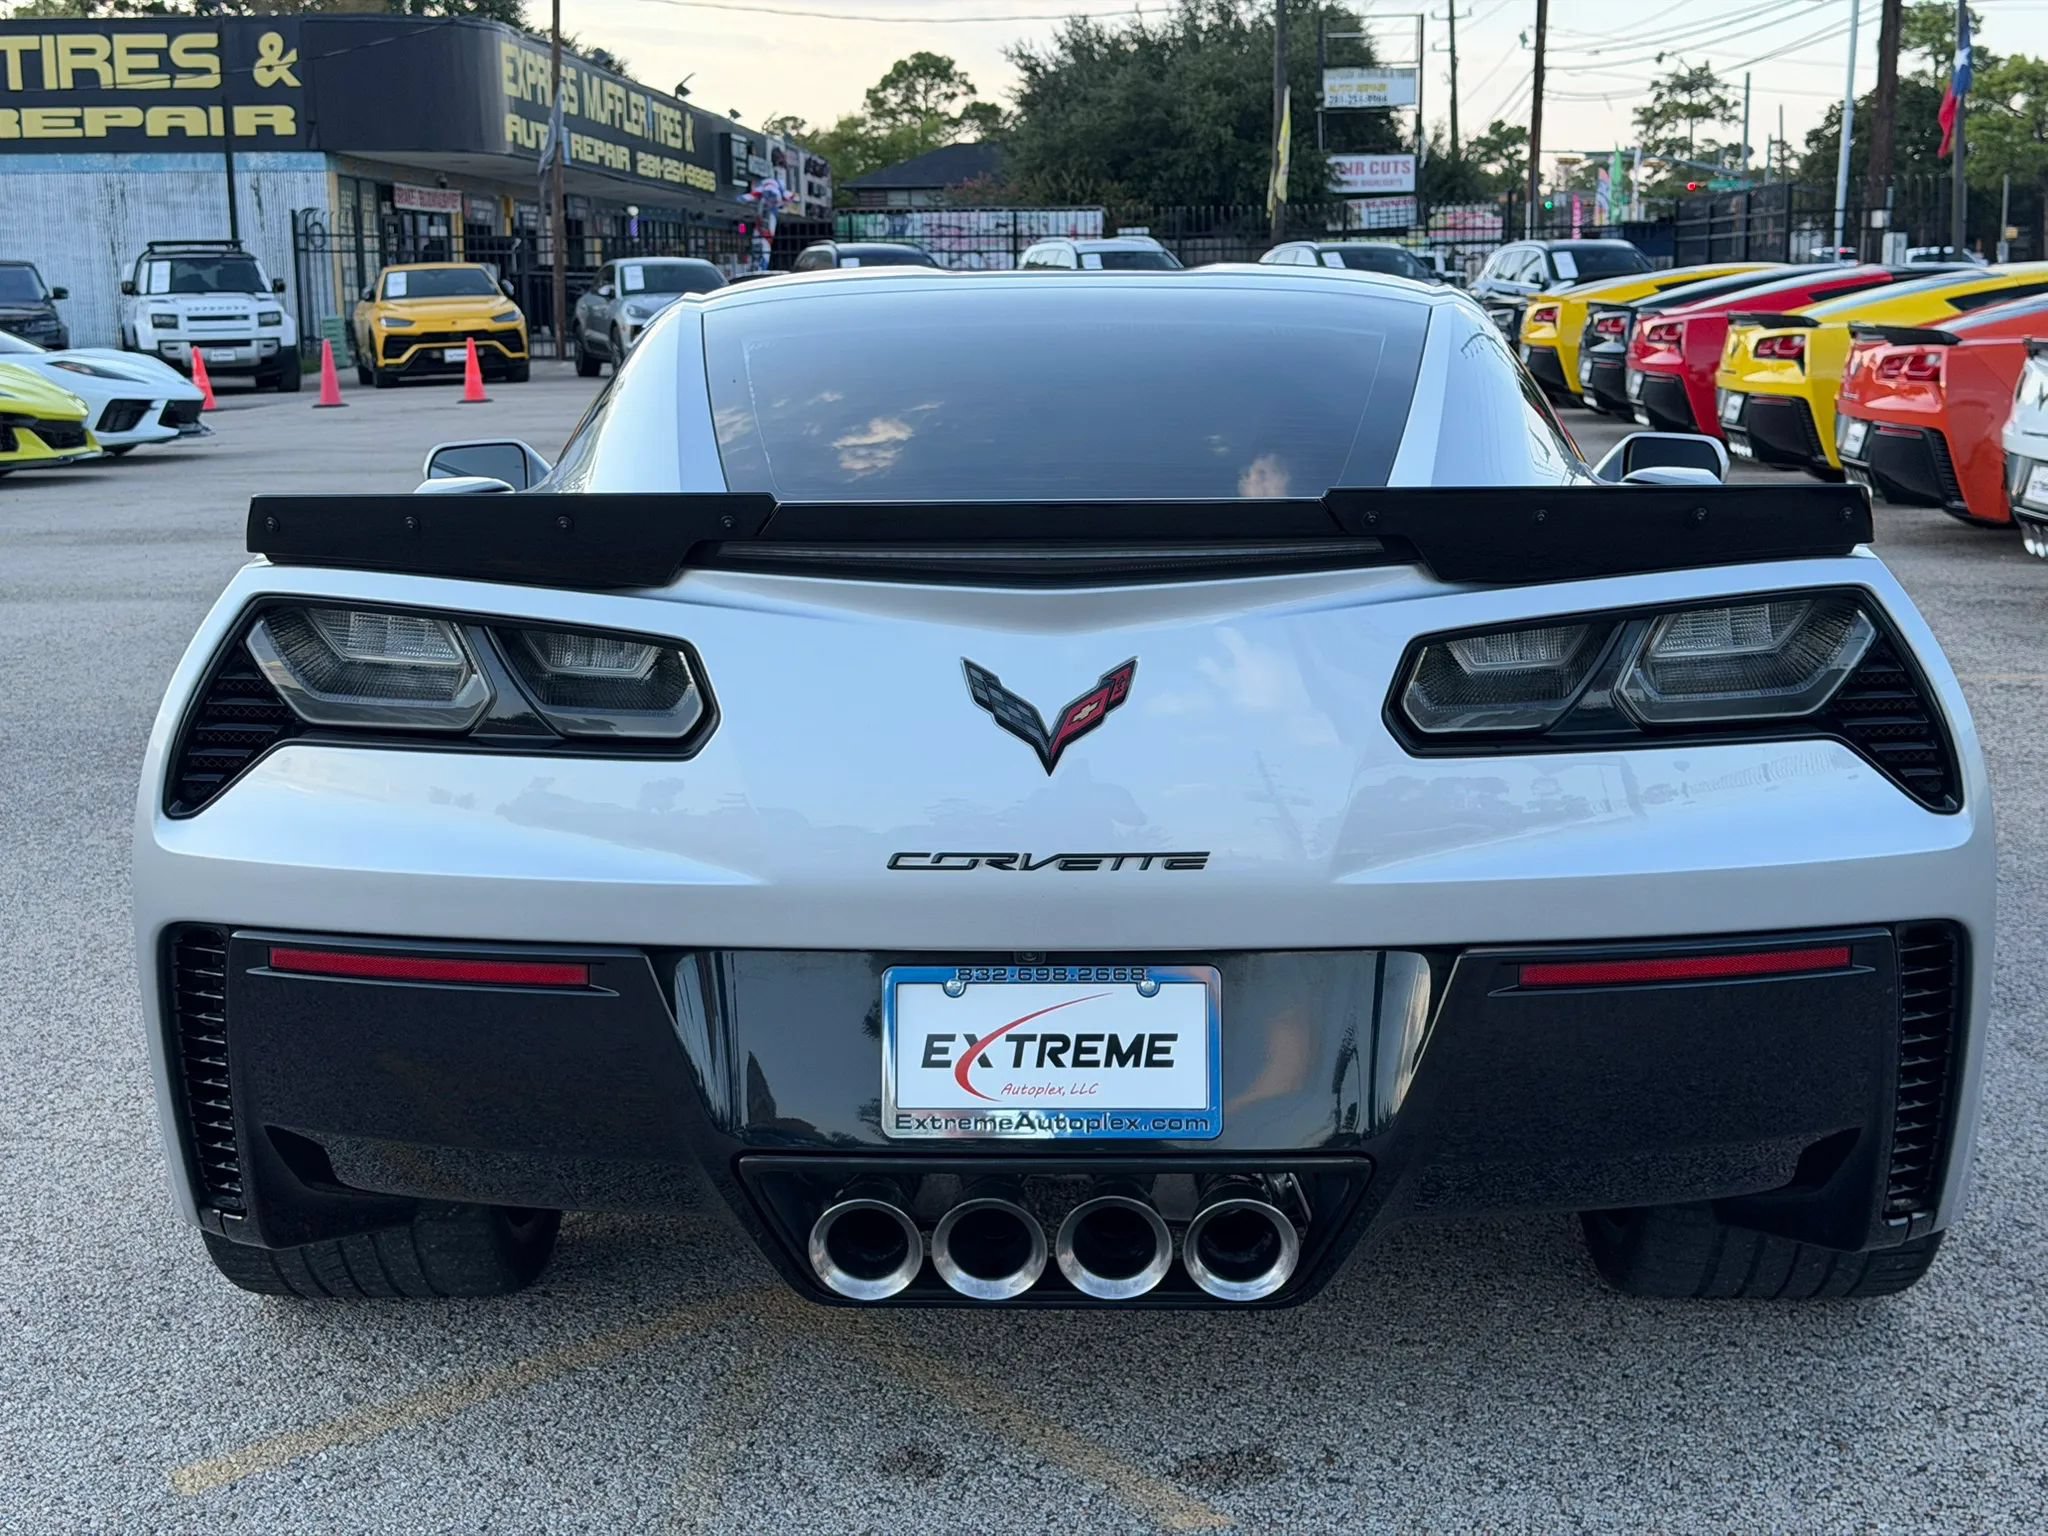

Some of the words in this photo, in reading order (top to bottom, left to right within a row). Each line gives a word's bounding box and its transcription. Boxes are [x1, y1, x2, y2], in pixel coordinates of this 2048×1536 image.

[0, 33, 221, 91] TIRES
[253, 31, 302, 88] &
[500, 41, 579, 116] EXPRSS
[582, 71, 649, 140] MUFFLER
[505, 113, 550, 151] AUT
[570, 132, 631, 172] REPAIR
[1369, 161, 1411, 175] CUTS
[886, 851, 1210, 871] CORVETTE
[920, 1033, 1179, 1069] EXTREME
[1000, 1082, 1067, 1098] Autoplex,
[1070, 1083, 1099, 1095] LLC
[895, 1112, 1209, 1133] ExtremeAutoplex.com
